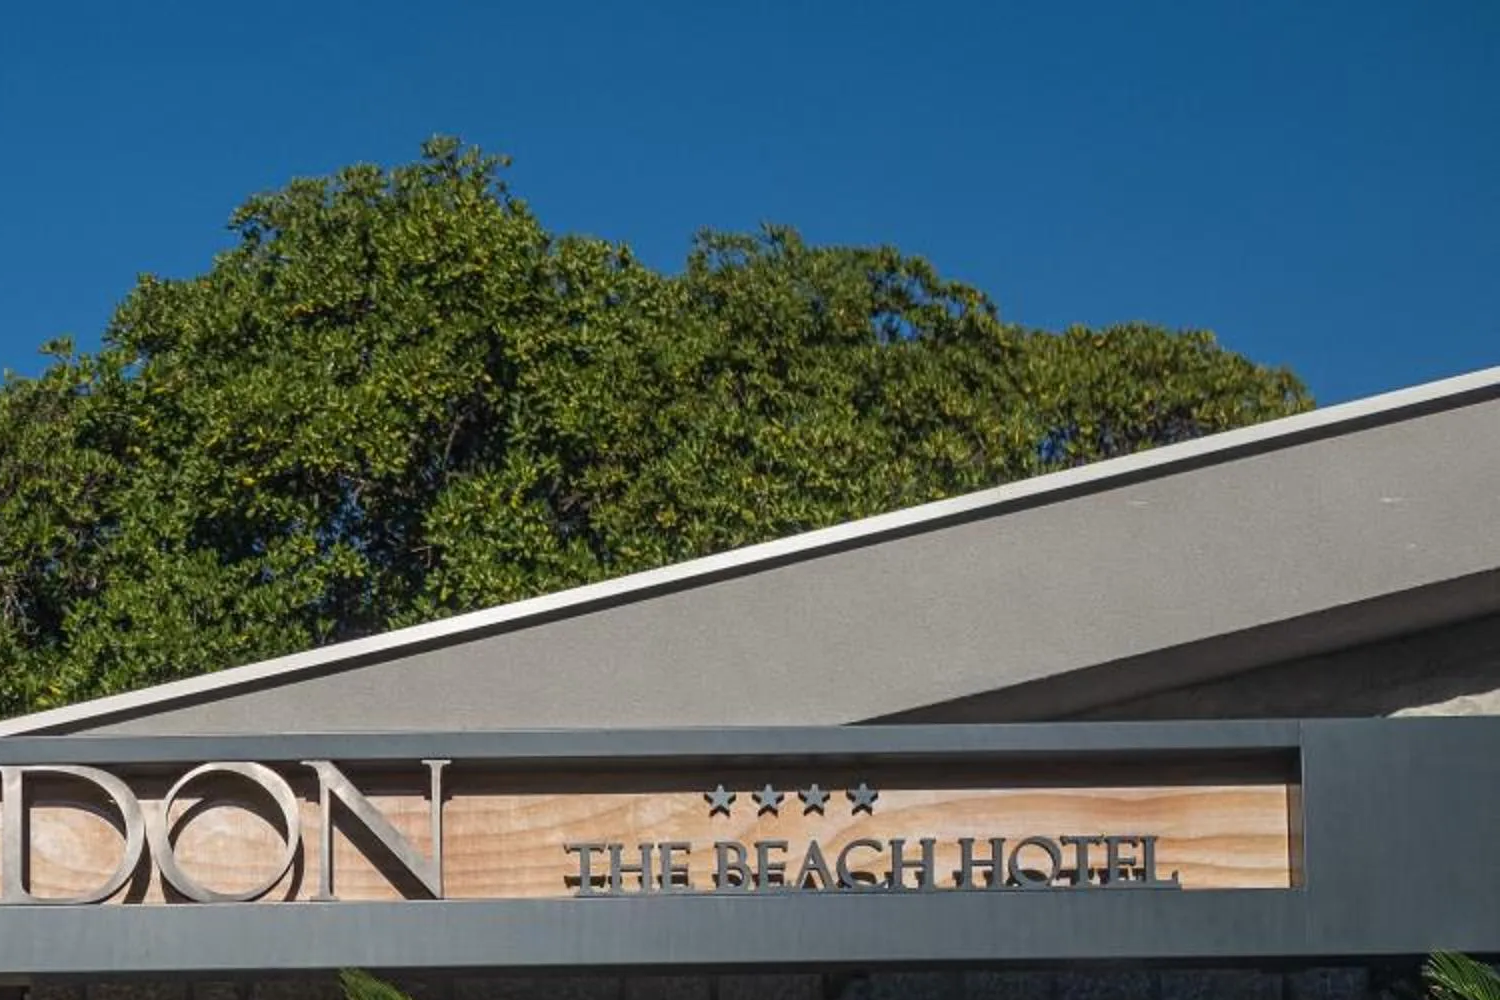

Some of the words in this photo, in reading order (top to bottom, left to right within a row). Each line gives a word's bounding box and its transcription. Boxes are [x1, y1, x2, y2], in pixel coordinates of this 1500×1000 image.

[564, 842, 691, 895] THE
[714, 839, 936, 892] BEACH
[957, 834, 1180, 891] HOTEL
